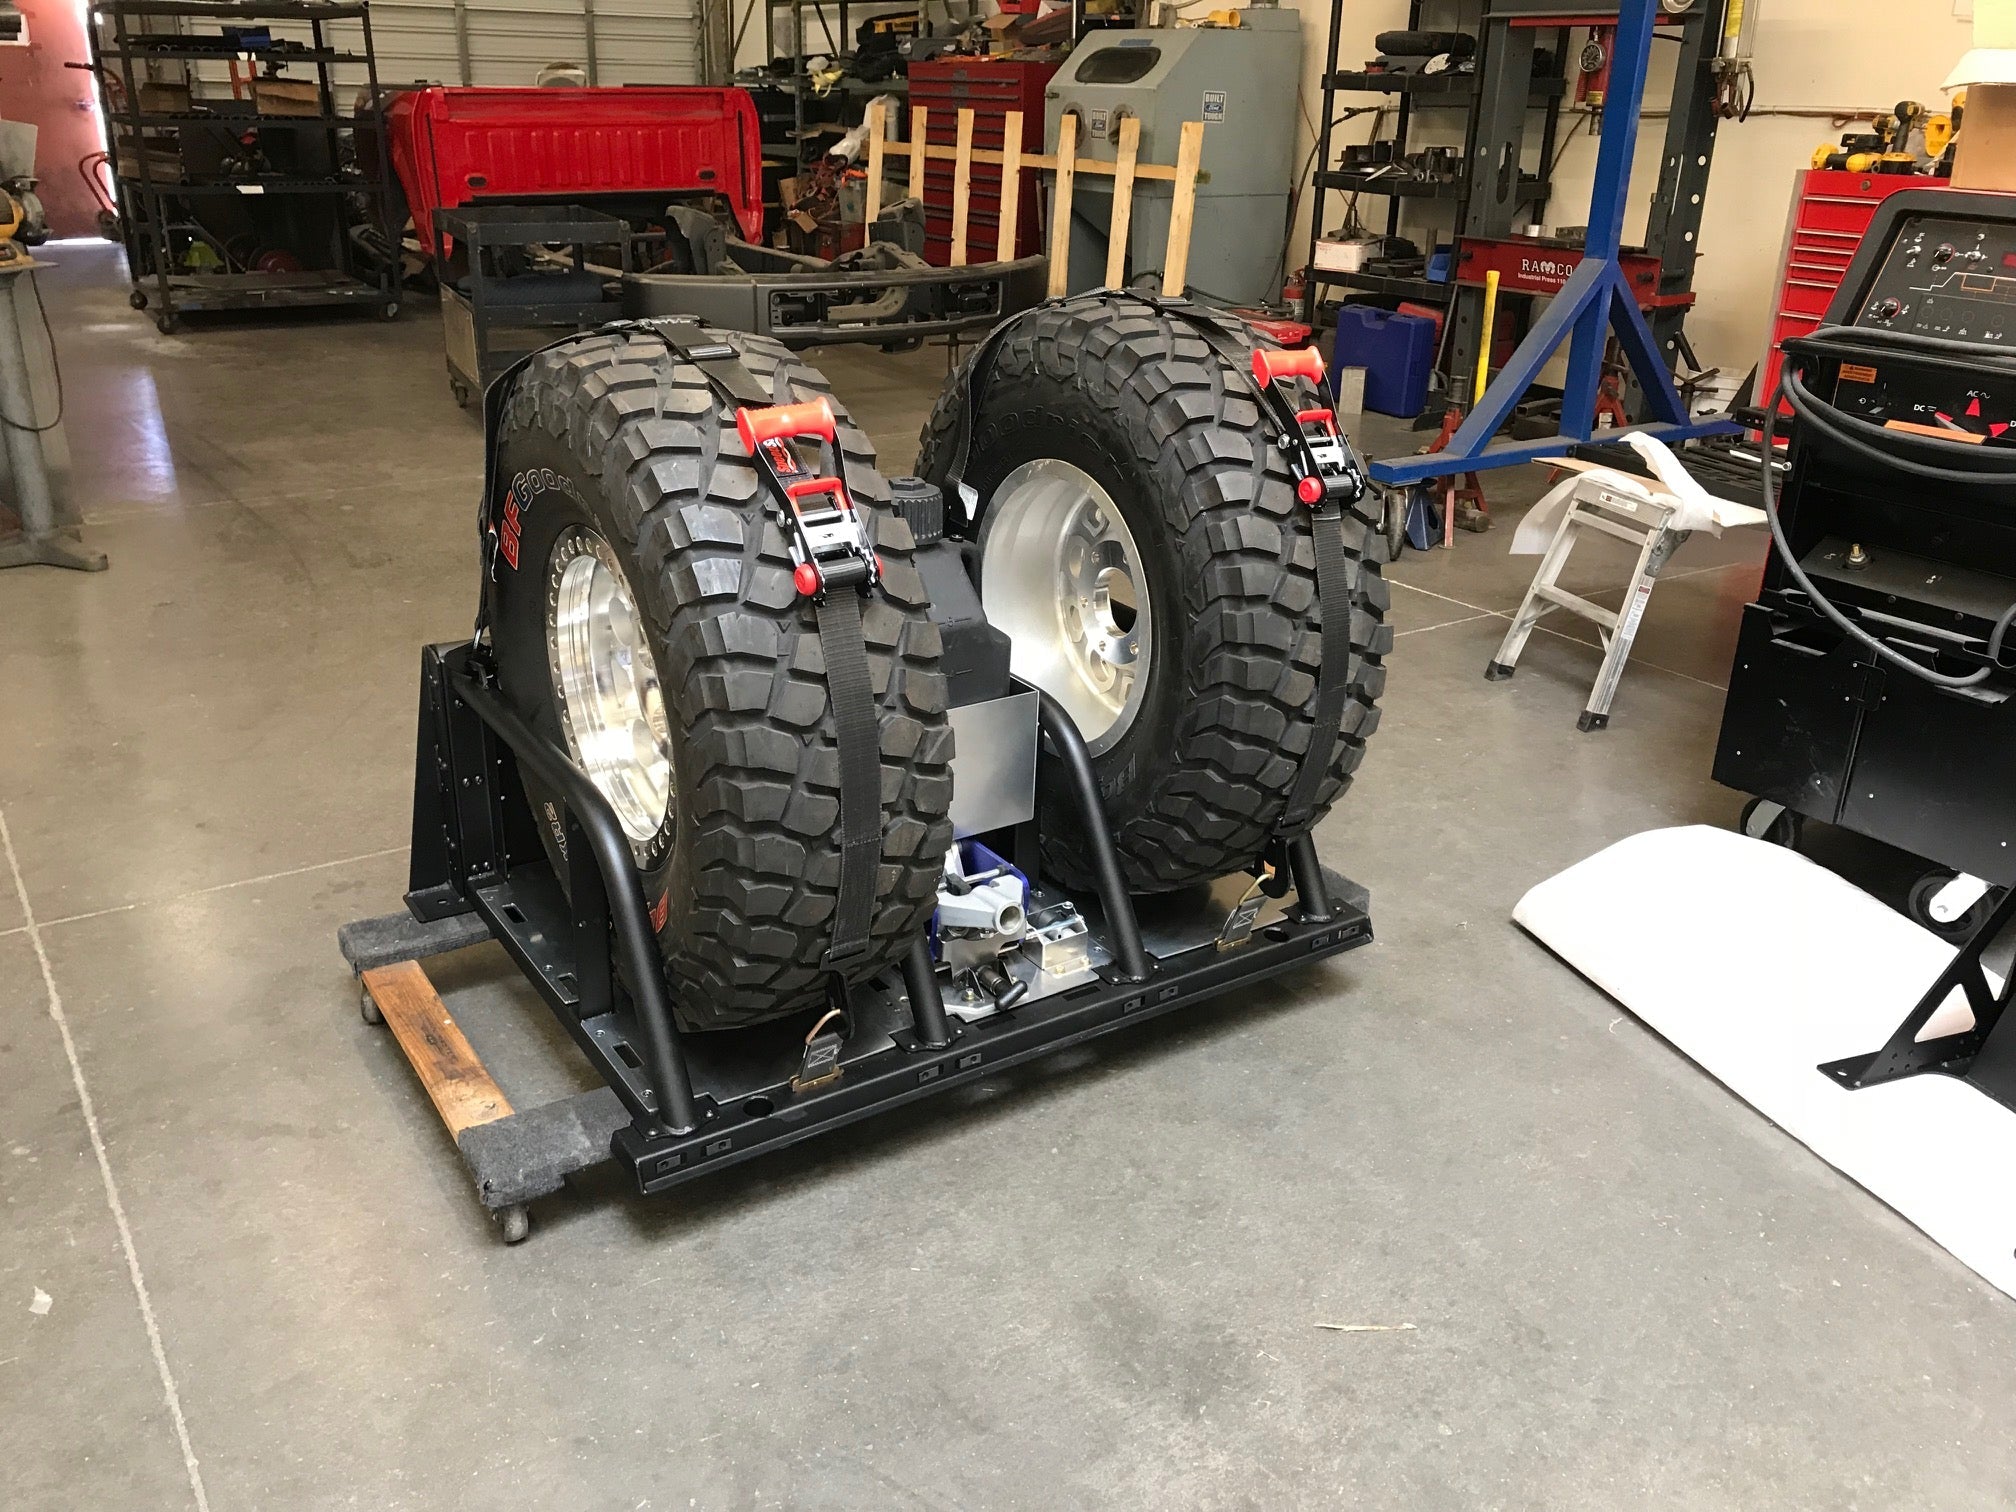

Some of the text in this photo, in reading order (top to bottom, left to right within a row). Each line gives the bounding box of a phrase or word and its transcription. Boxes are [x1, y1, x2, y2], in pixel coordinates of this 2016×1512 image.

[1205, 93, 1224, 103] BUILT
[1517, 272, 1541, 281] Industrial
[1541, 275, 1557, 284] Press
[1966, 389, 1979, 398] AC
[1913, 404, 1925, 412] DC
